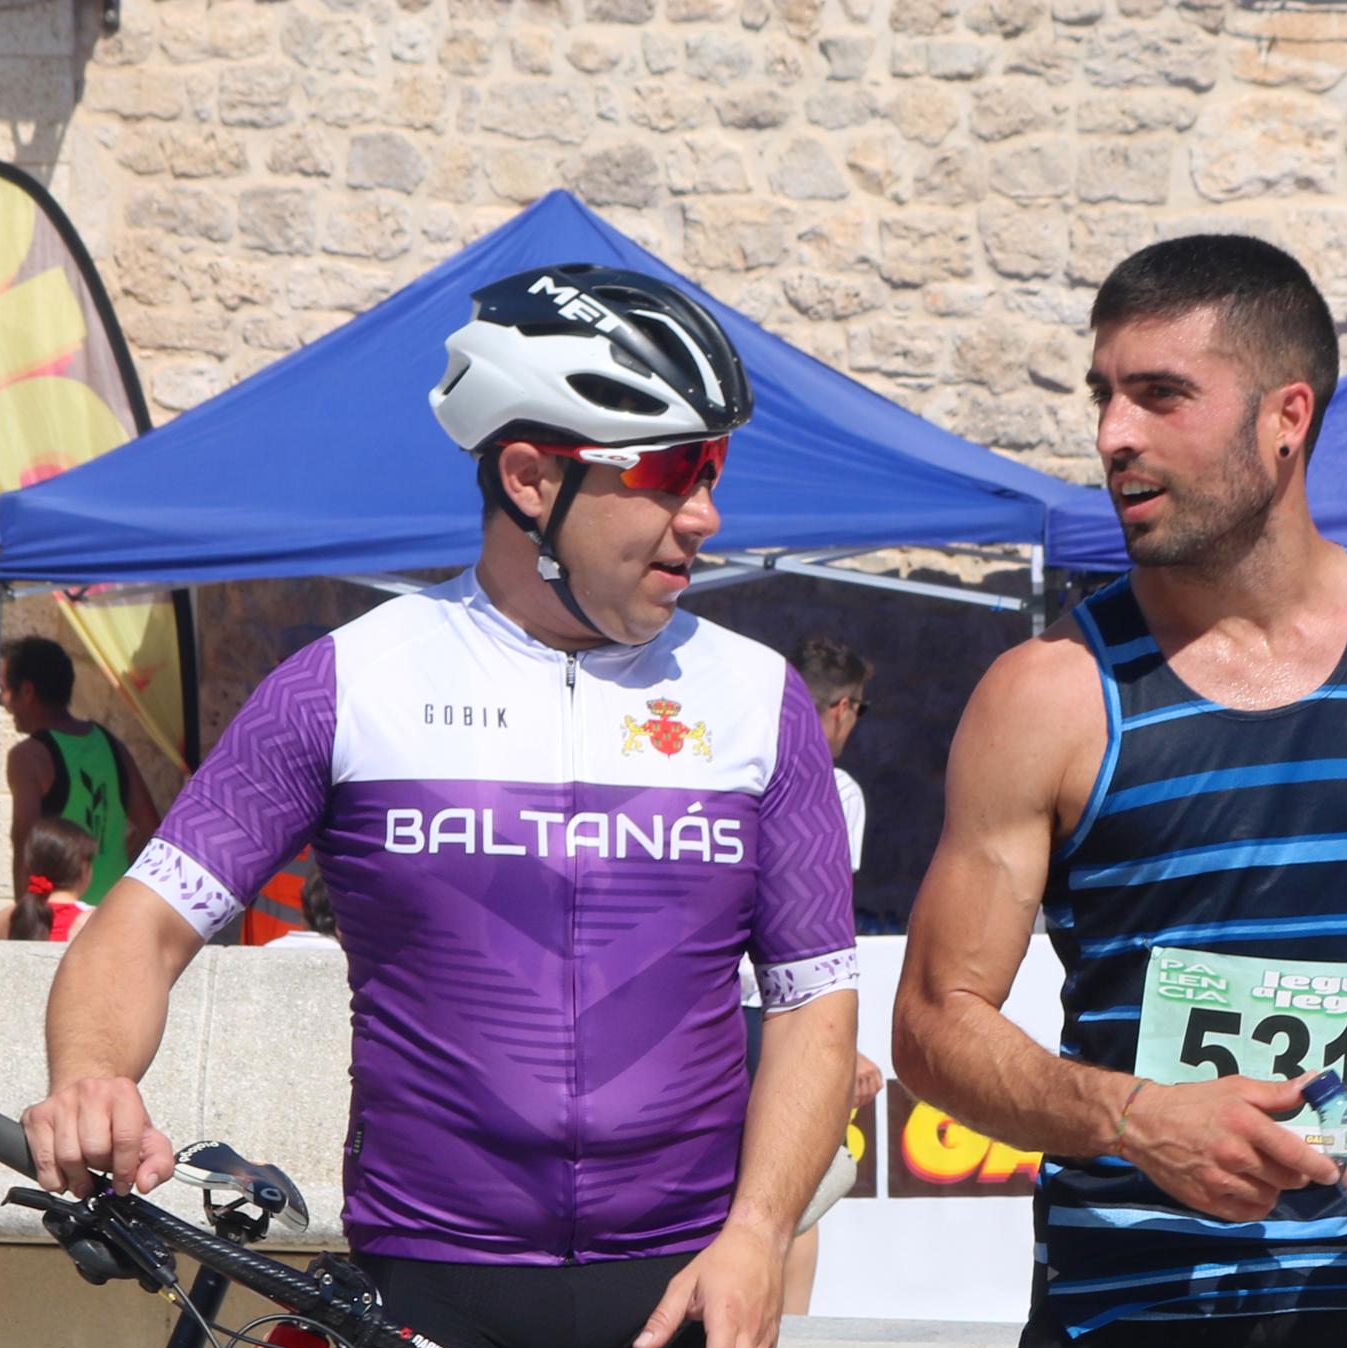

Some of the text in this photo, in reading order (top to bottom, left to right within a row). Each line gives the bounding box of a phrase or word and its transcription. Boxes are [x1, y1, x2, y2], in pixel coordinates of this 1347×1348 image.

[527, 275, 632, 334] MET
[424, 703, 509, 729] GOBIK
[384, 801, 745, 864] BALTANÁS
[1160, 958, 1216, 976] PA
[1159, 971, 1226, 990] LEN
[1158, 986, 1228, 1004] CIA
